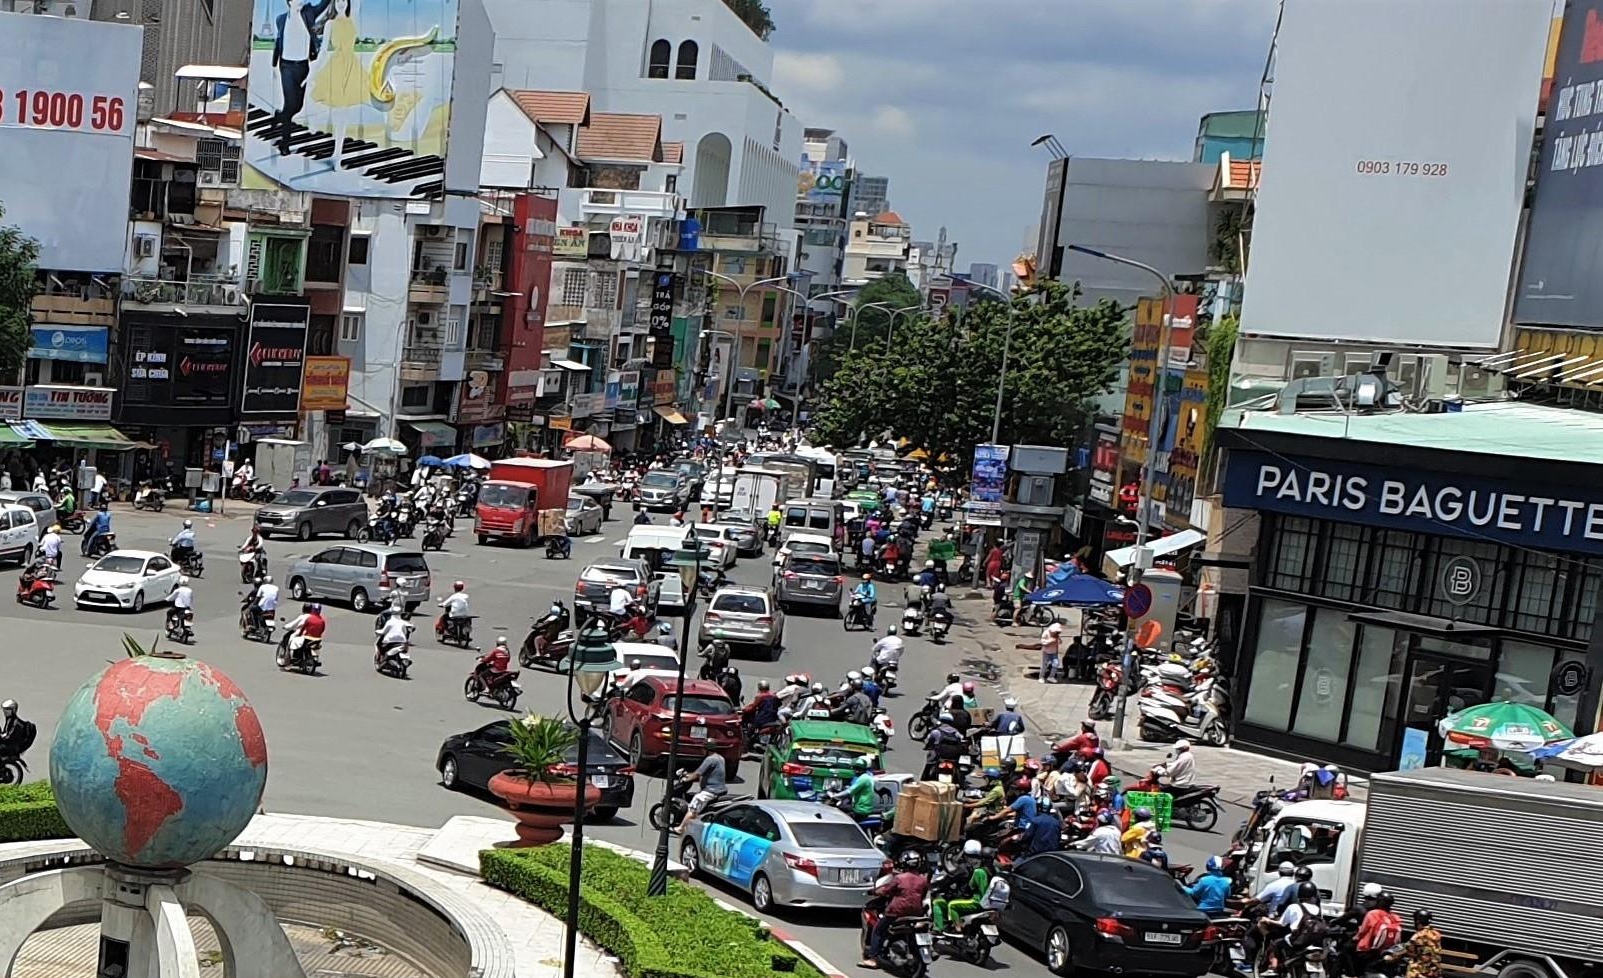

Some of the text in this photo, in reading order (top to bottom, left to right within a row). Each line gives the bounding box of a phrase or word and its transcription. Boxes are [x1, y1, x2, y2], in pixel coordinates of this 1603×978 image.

[14, 89, 84, 129] 1900
[90, 95, 125, 131] 56
[1356, 159, 1448, 177] 0903 179 928
[651, 315, 670, 328] 0%
[1256, 464, 1603, 540] PARIS BAGUETTE
